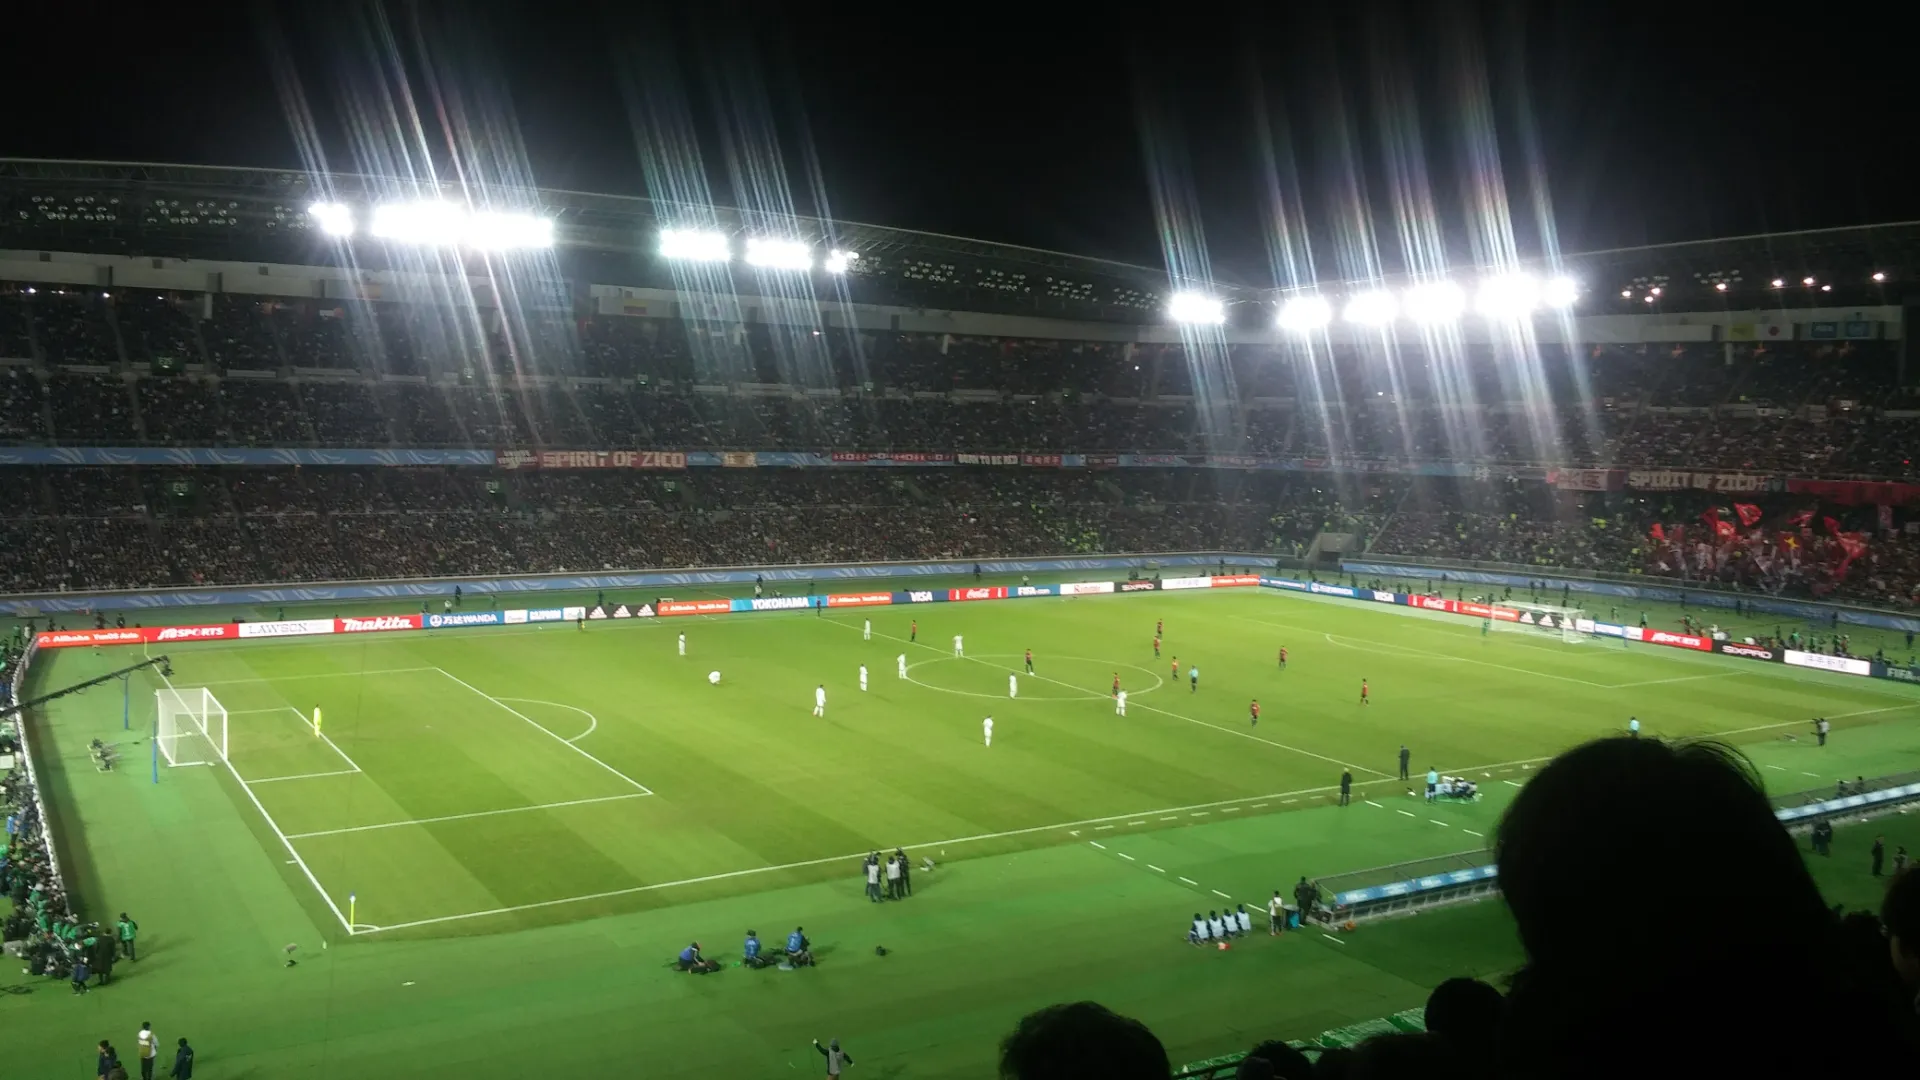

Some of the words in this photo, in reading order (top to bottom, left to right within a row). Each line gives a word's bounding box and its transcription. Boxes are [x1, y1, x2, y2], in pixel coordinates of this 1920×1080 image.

[543, 451, 608, 468] SPIRIT
[613, 451, 638, 468] OF
[642, 452, 685, 468] ZICO
[751, 596, 810, 609] YOKOHAMA
[248, 622, 308, 633] LAWSON
